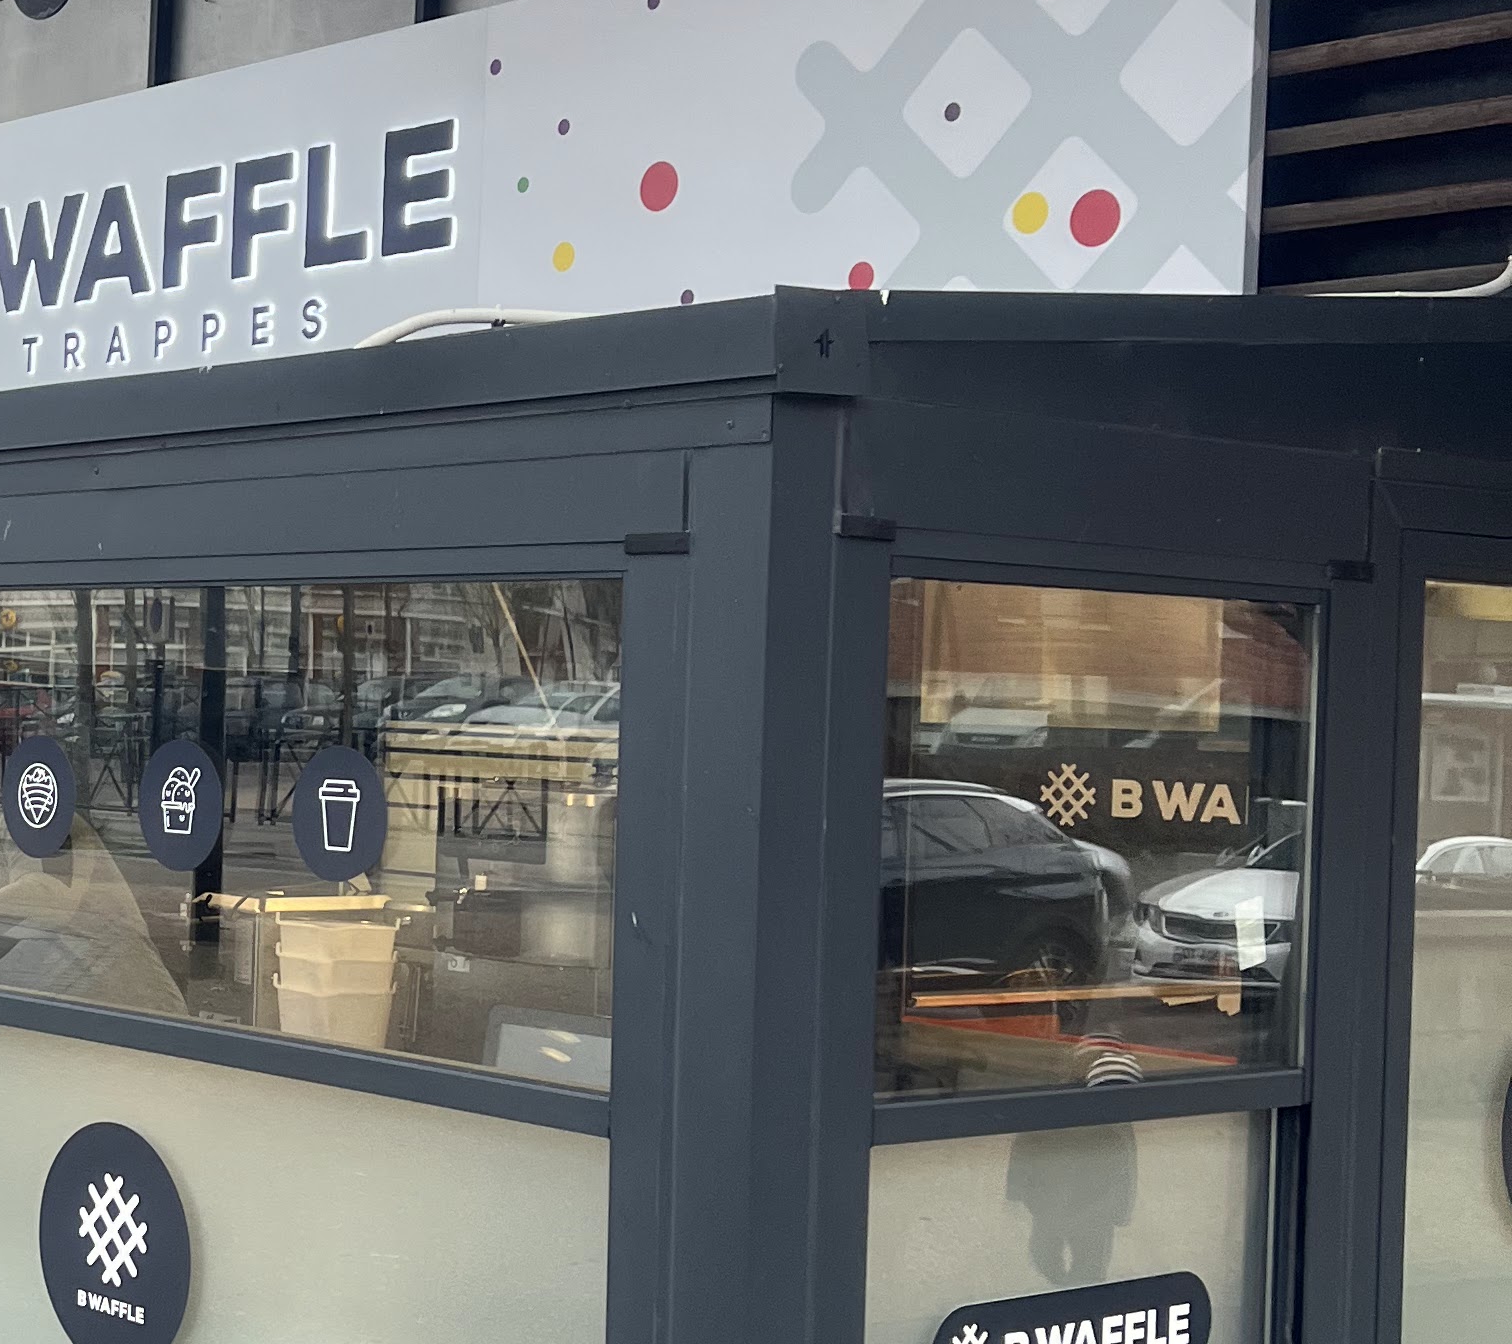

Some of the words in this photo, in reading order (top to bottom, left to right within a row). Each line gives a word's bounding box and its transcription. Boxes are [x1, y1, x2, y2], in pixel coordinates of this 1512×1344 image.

[22, 297, 327, 373] TRAPPES
[1152, 779, 1249, 825] WA
[88, 1291, 145, 1325] WAFFLE
